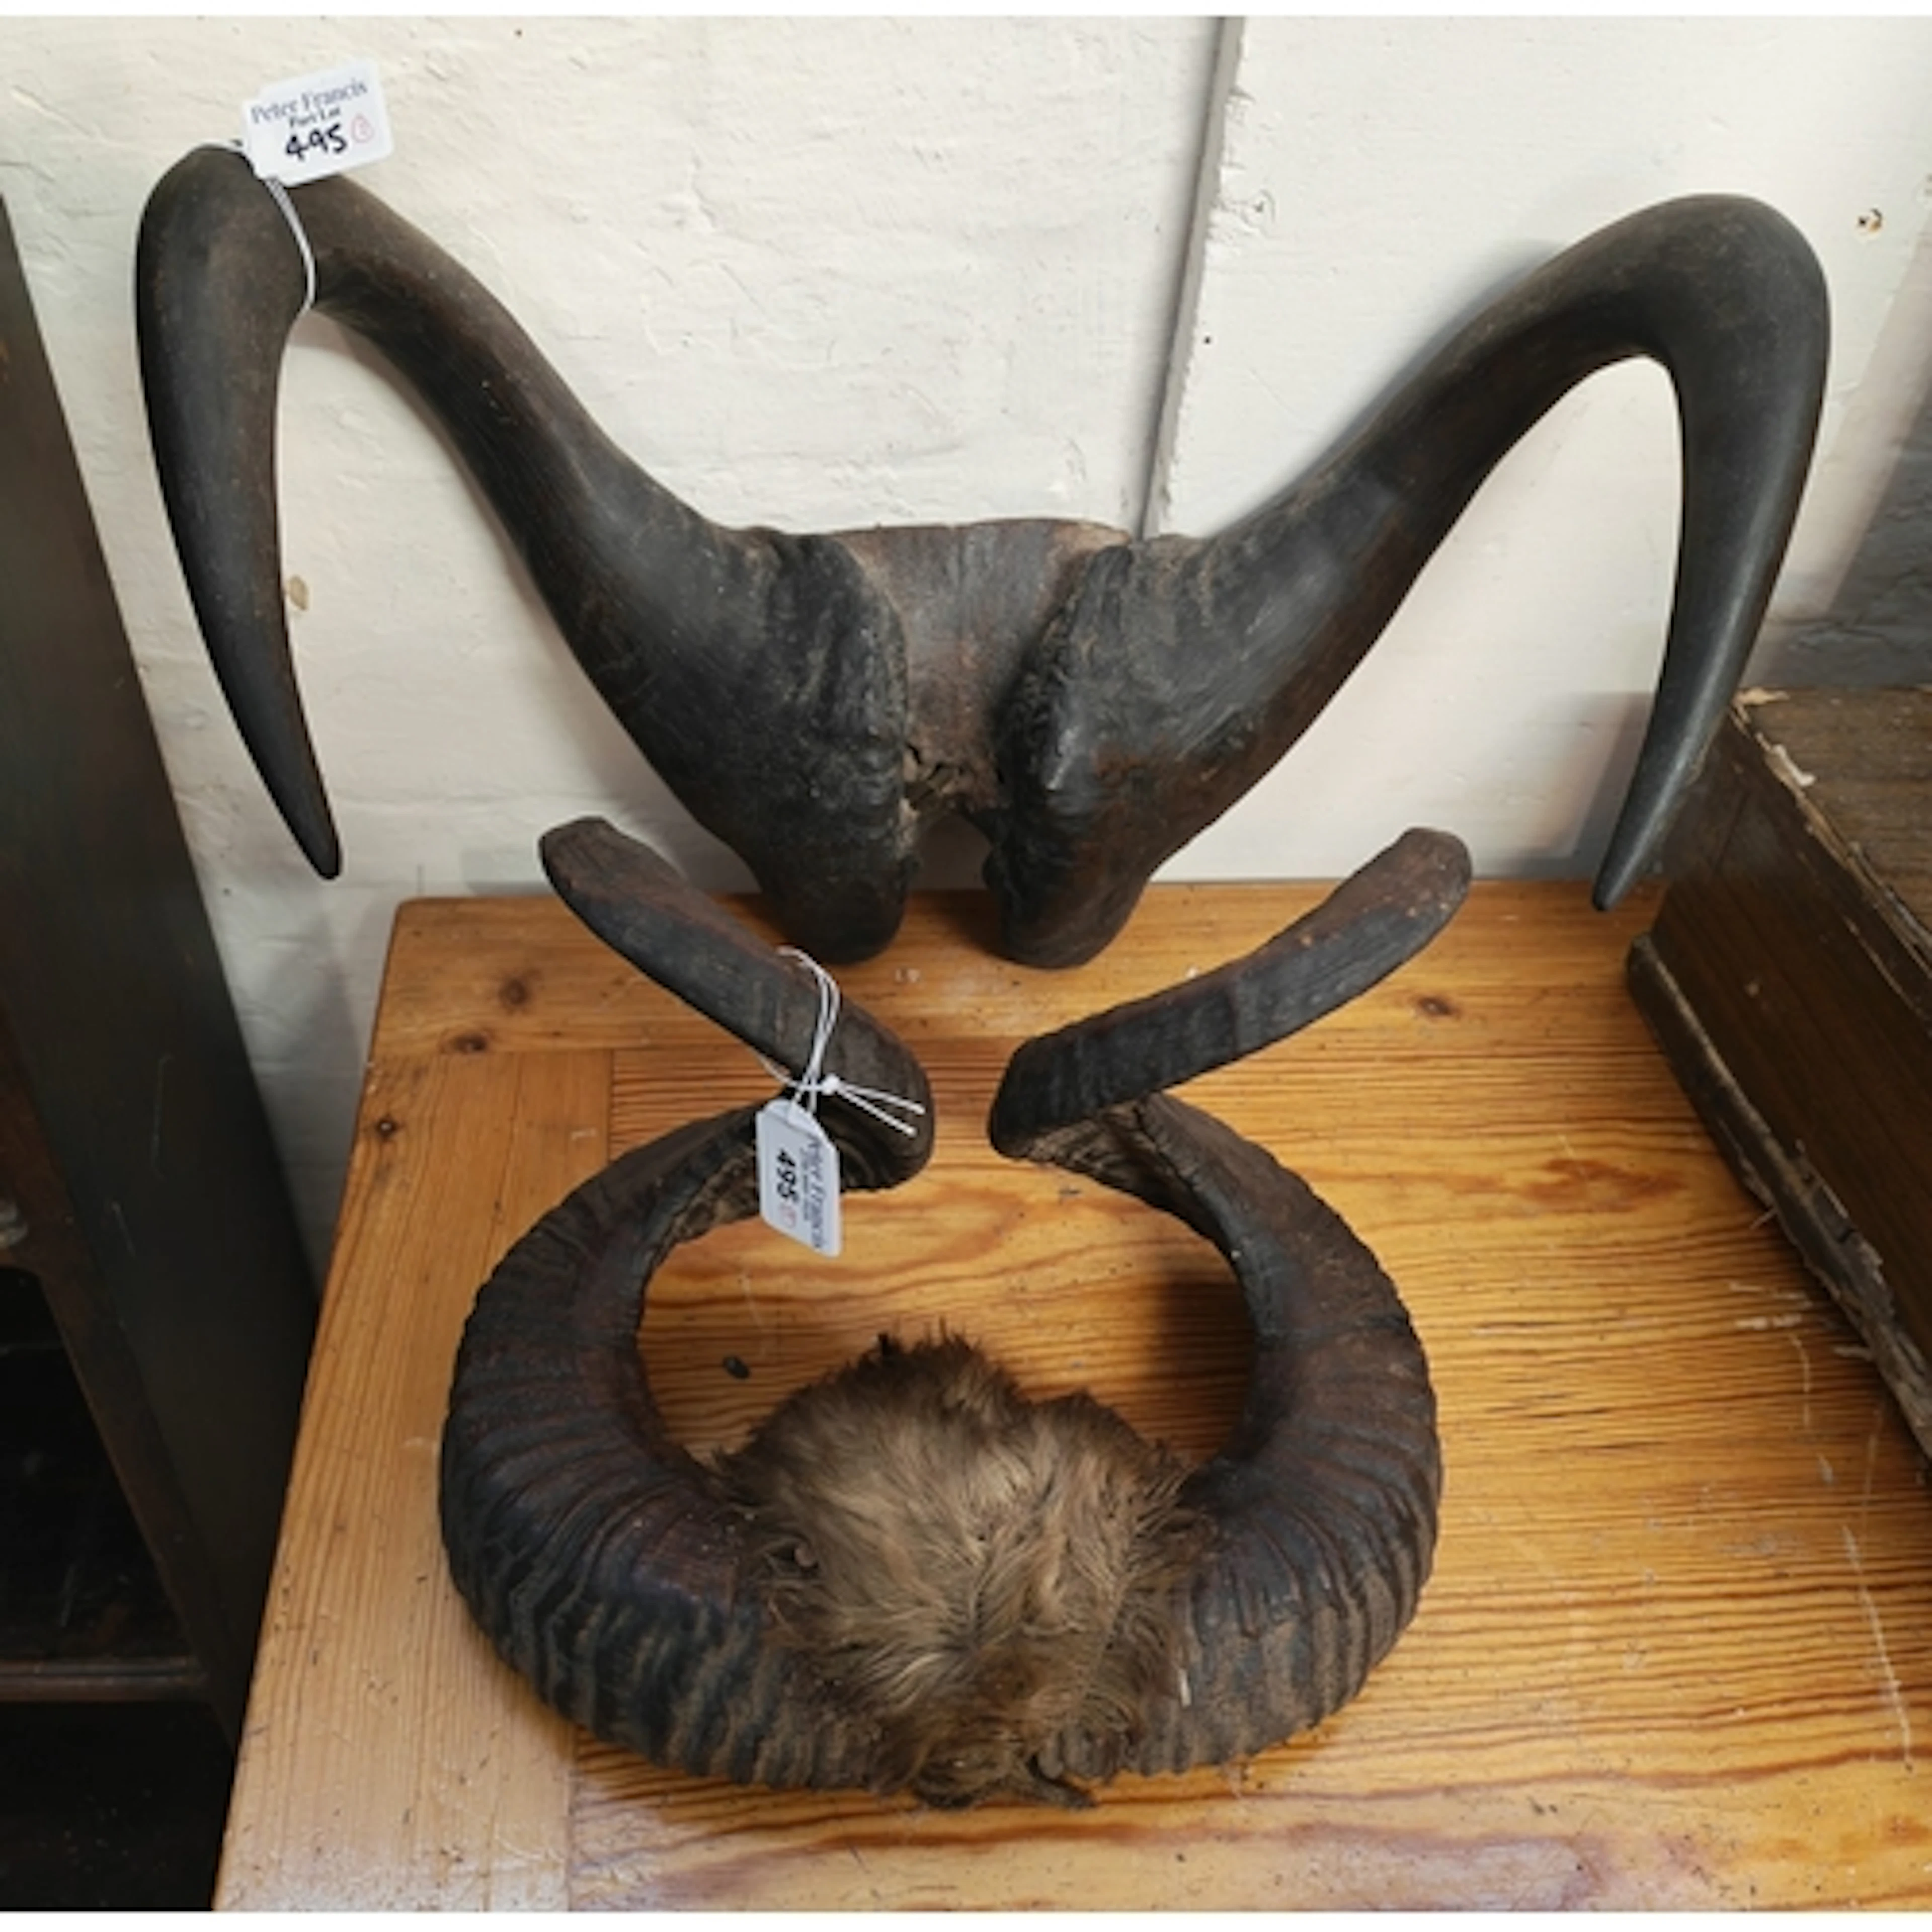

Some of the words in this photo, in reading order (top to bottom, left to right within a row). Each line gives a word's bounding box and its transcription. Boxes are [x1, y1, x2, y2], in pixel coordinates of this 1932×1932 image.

[252, 99, 298, 124] Peter
[301, 75, 368, 111] Francis
[285, 123, 347, 161] 495
[776, 1148, 800, 1203] 495
